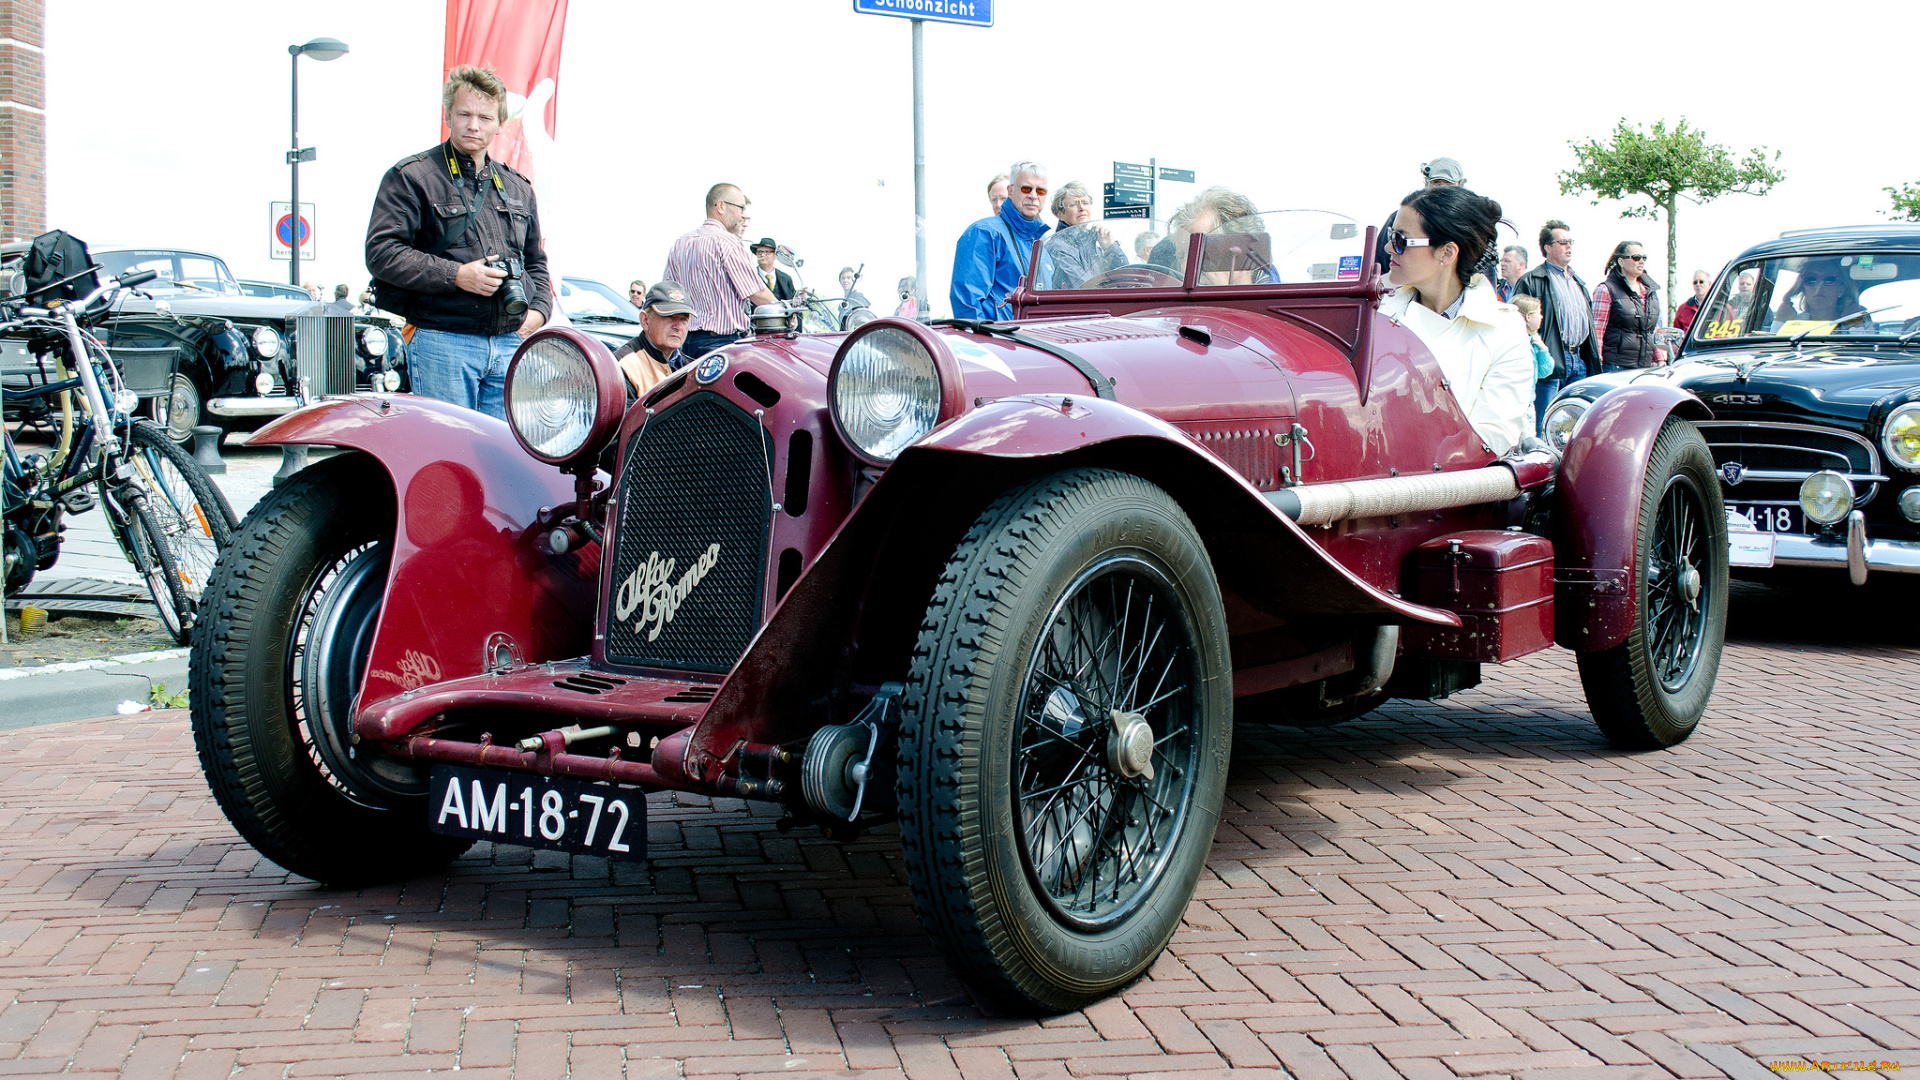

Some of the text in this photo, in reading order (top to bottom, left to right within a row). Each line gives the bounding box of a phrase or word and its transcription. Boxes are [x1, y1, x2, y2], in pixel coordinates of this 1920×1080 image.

[1705, 320, 1743, 339] 345
[1713, 394, 1763, 404] 403
[1092, 516, 1188, 564] MICHELIN
[616, 551, 676, 635] Alfa
[646, 543, 721, 642] Romeo
[438, 777, 630, 852] AM-18-72
[1058, 925, 1156, 975] MICHELIN
